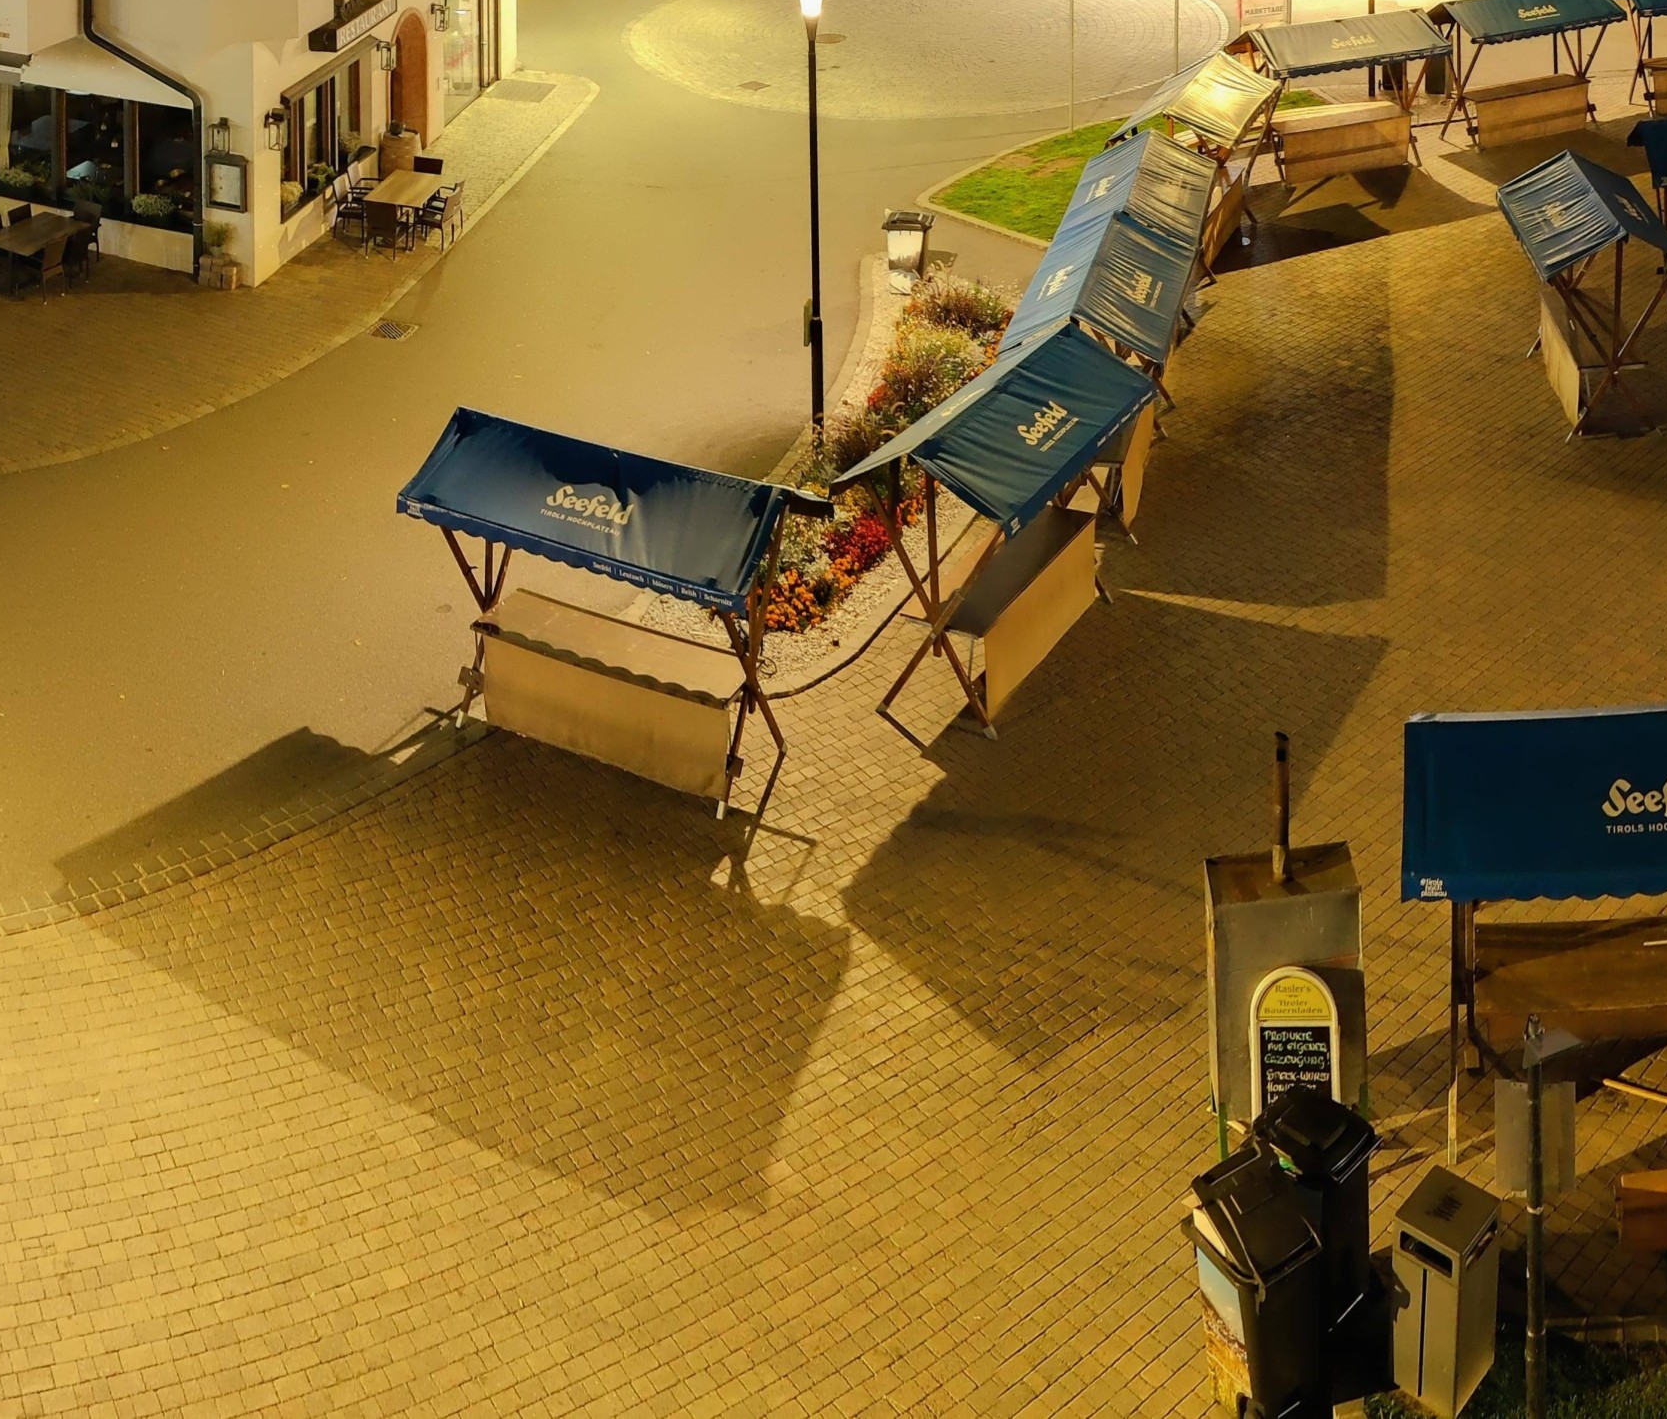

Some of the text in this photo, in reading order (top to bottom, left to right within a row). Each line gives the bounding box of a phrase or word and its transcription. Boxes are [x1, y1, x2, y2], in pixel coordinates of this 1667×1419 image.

[1244, 5, 1285, 16] MARKTTAGE
[1517, 4, 1558, 19] Seefeld
[1331, 34, 1375, 49] Seefeld
[1017, 400, 1068, 446] Seefeld
[545, 484, 635, 525] Seefeld
[539, 508, 621, 536] TIROLS HOCHPLATEAU
[1605, 823, 1645, 835] TIROLS
[1277, 999, 1309, 1007] Tiroler
[1263, 1006, 1323, 1015] Bauernladen
[1263, 1030, 1313, 1042] PRODUKTE
